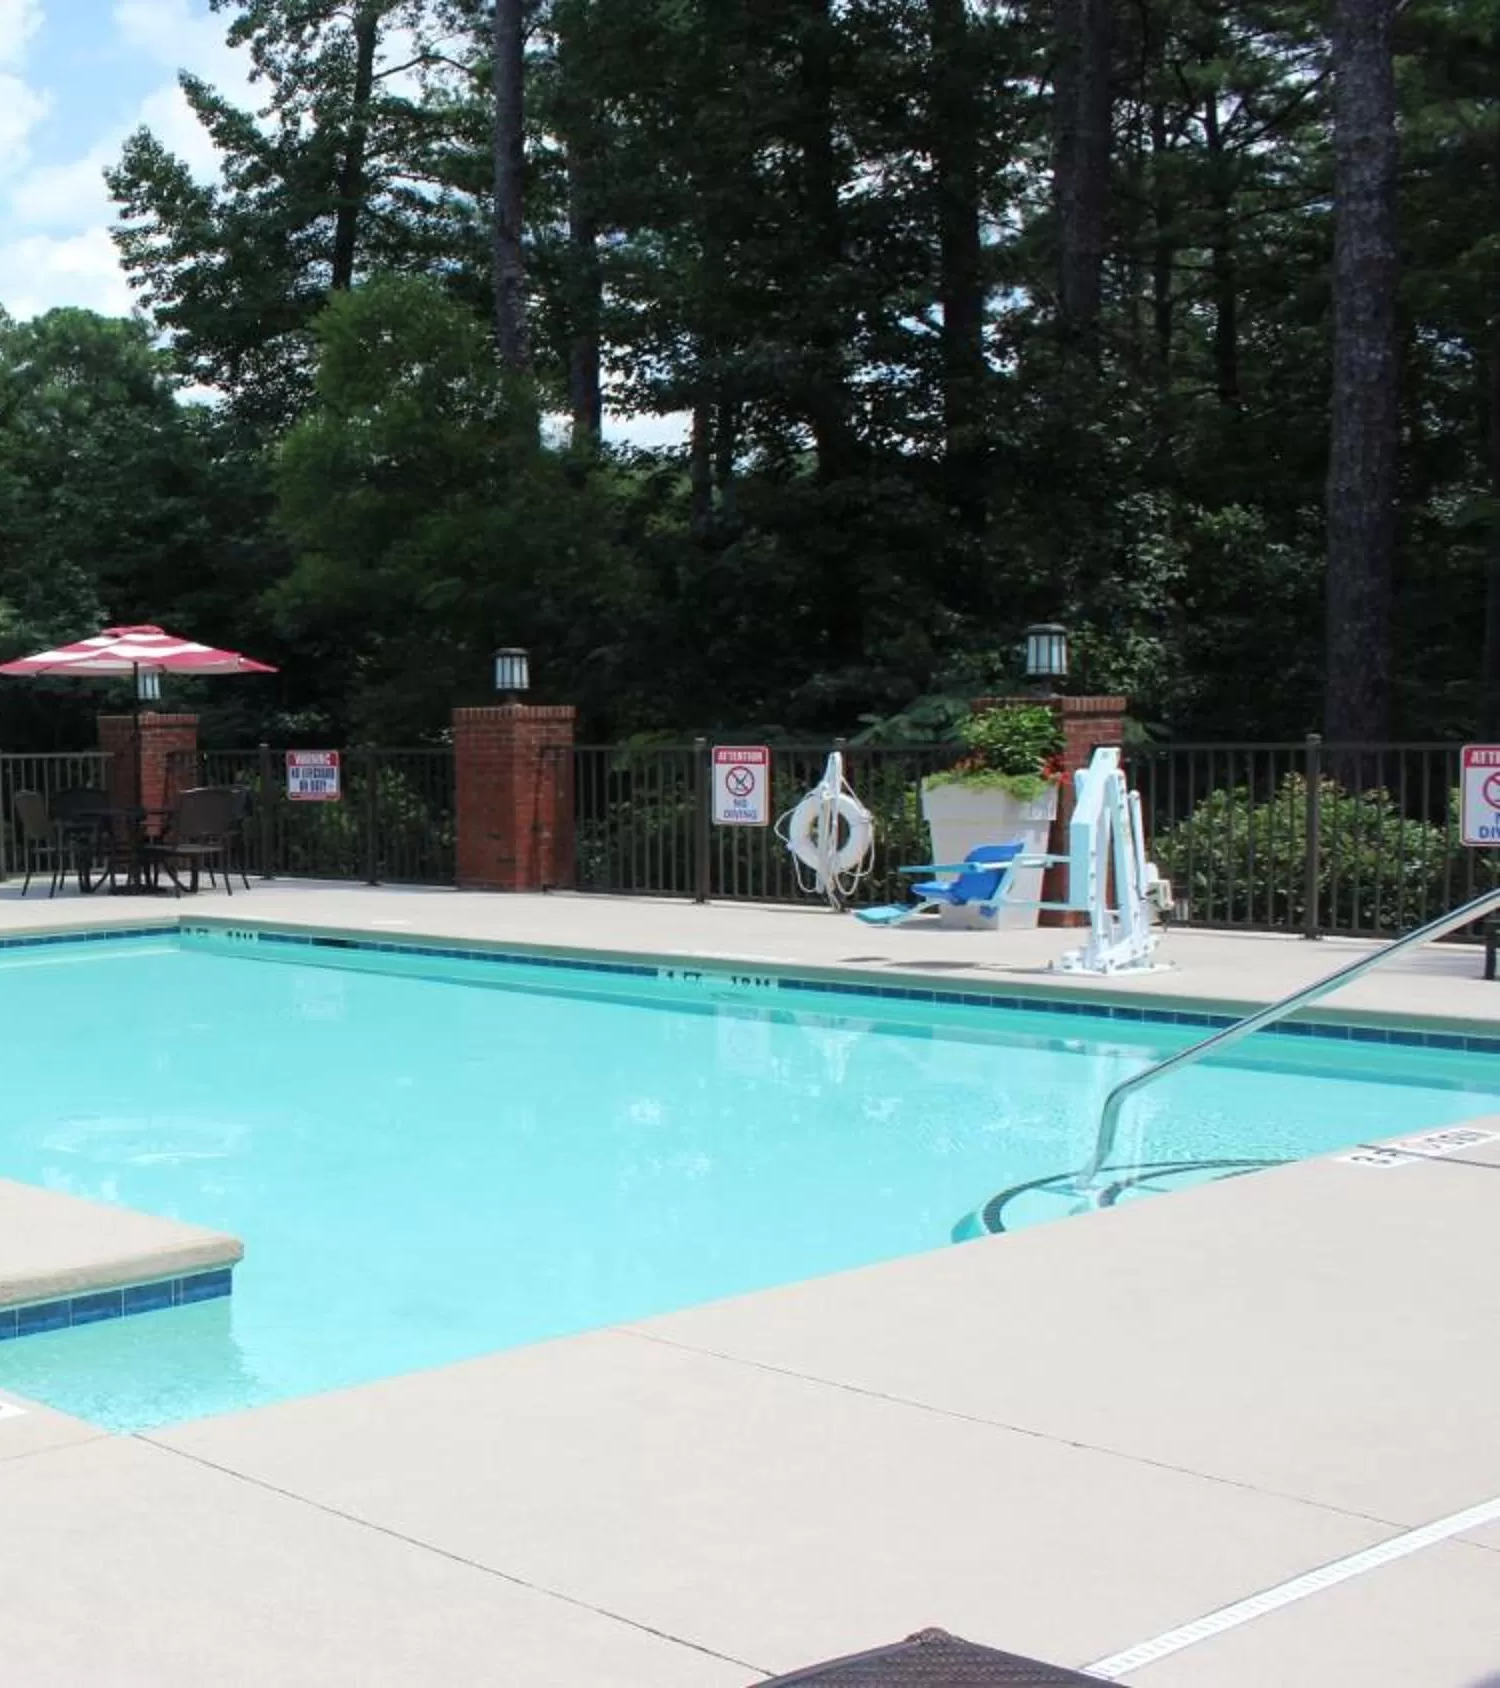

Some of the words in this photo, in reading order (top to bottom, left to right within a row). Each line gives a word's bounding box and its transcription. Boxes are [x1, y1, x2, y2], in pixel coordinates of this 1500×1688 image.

[717, 751, 763, 763] ATTENTION
[734, 799, 748, 808] NO
[723, 809, 757, 820] DIVING
